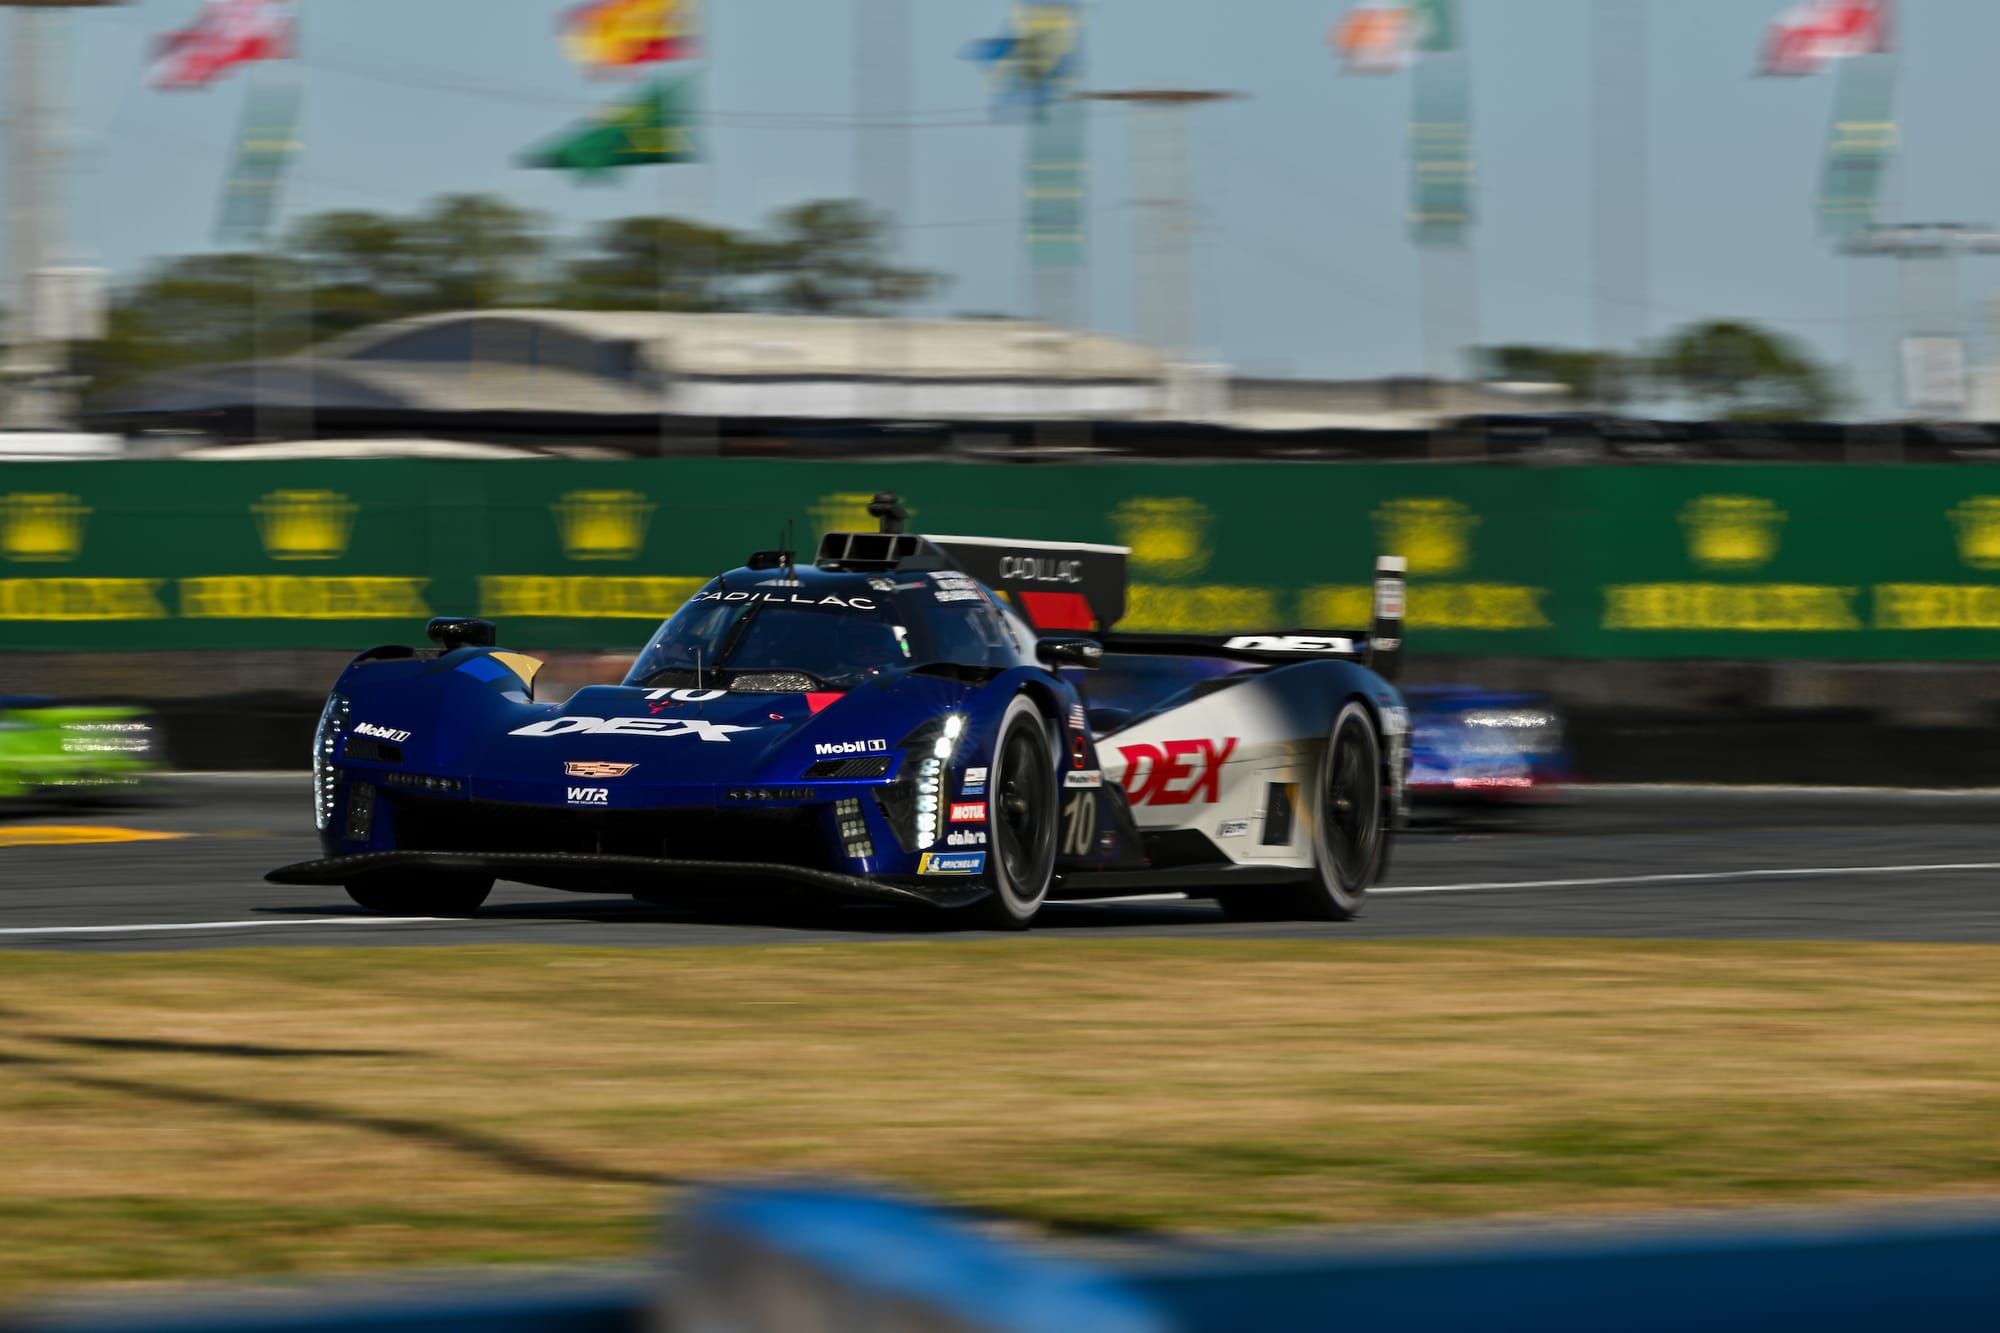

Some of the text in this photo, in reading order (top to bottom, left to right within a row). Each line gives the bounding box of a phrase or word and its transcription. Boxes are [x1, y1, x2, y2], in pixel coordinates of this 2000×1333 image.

[1001, 556, 1083, 583] CADILLAC
[690, 592, 877, 610] CADILLAC
[353, 722, 411, 742] Mobil 1
[508, 716, 762, 742] DEX
[815, 739, 886, 755] Mobil 1
[1117, 737, 1241, 807] DEX
[567, 787, 609, 801] WTR
[951, 805, 985, 820] MOTUL
[1062, 791, 1097, 856] 10
